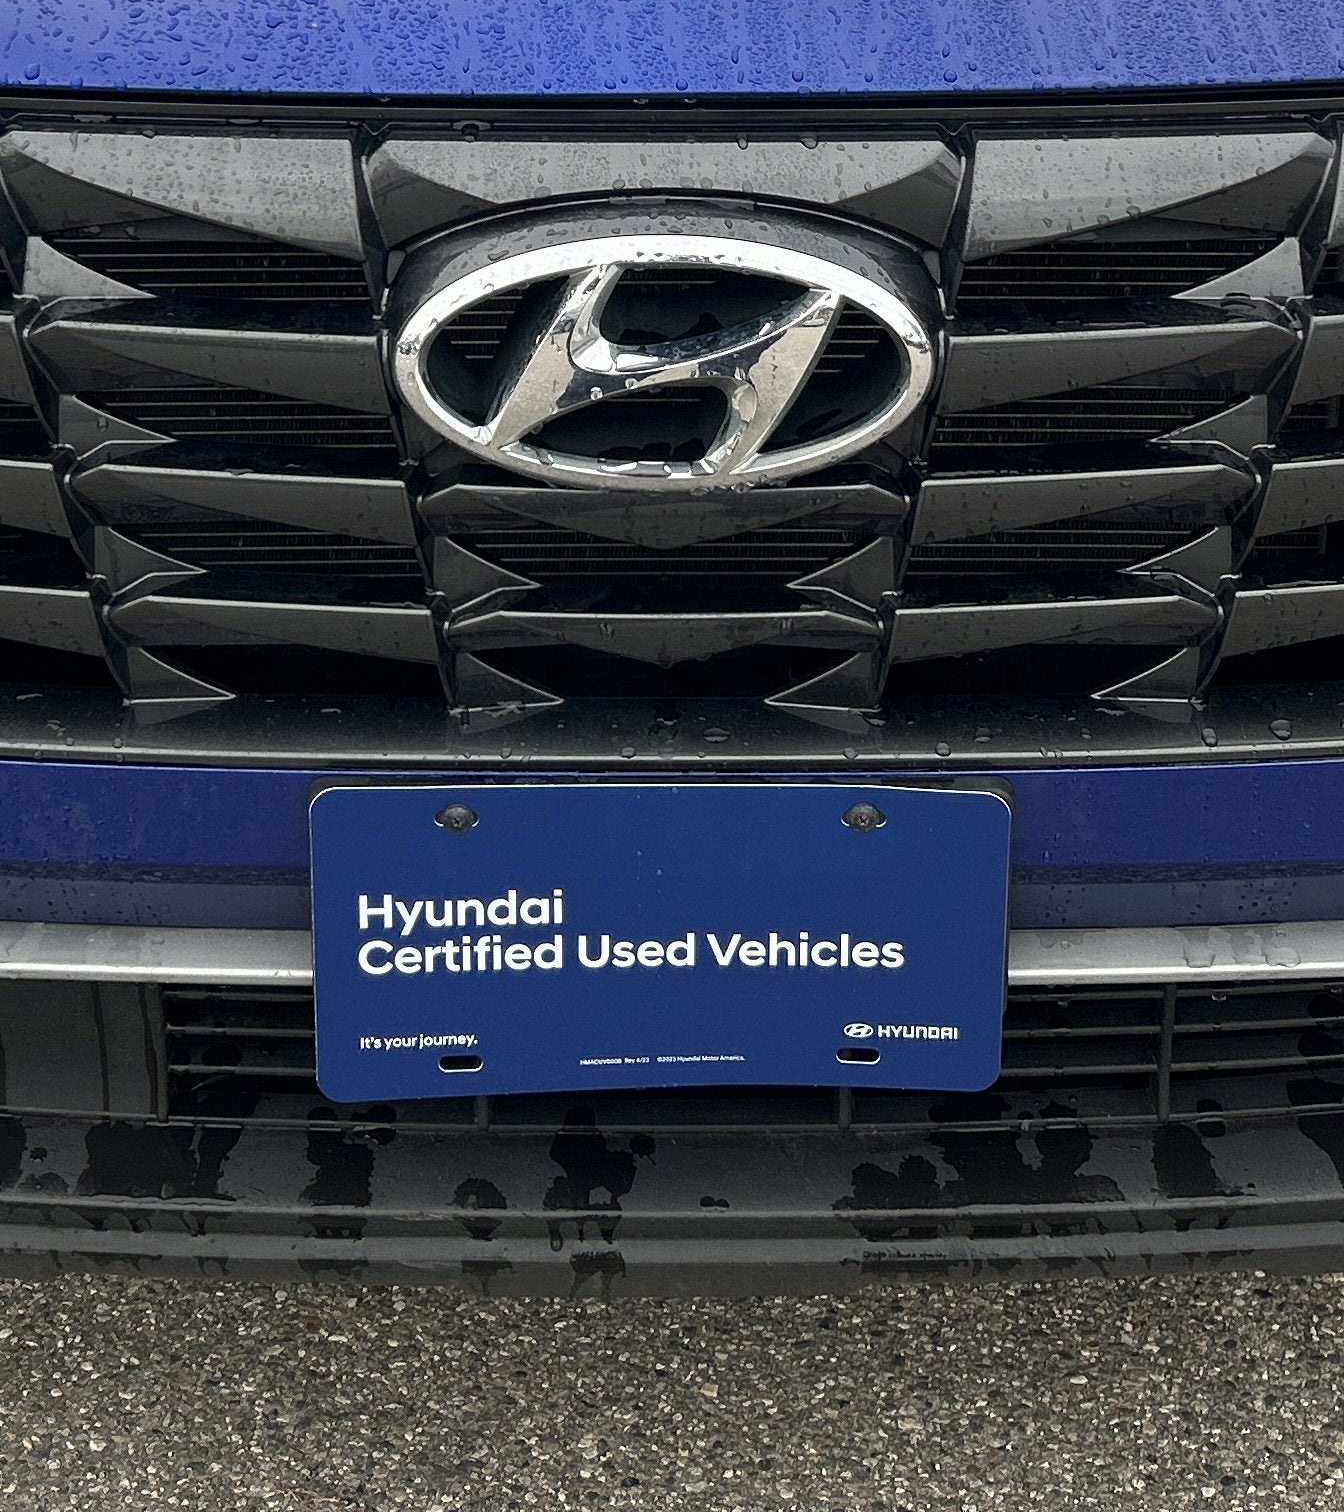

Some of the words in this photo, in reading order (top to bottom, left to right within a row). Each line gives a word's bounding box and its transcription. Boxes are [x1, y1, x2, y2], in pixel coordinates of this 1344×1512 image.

[358, 888, 563, 938] Hyundai
[358, 934, 563, 975] Certified
[578, 932, 696, 969] Used
[706, 931, 905, 968] Vehicles
[360, 1036, 382, 1049] It's
[383, 1036, 417, 1051] your
[418, 1033, 478, 1050] journey.
[877, 1024, 958, 1040] HYUNDAI
